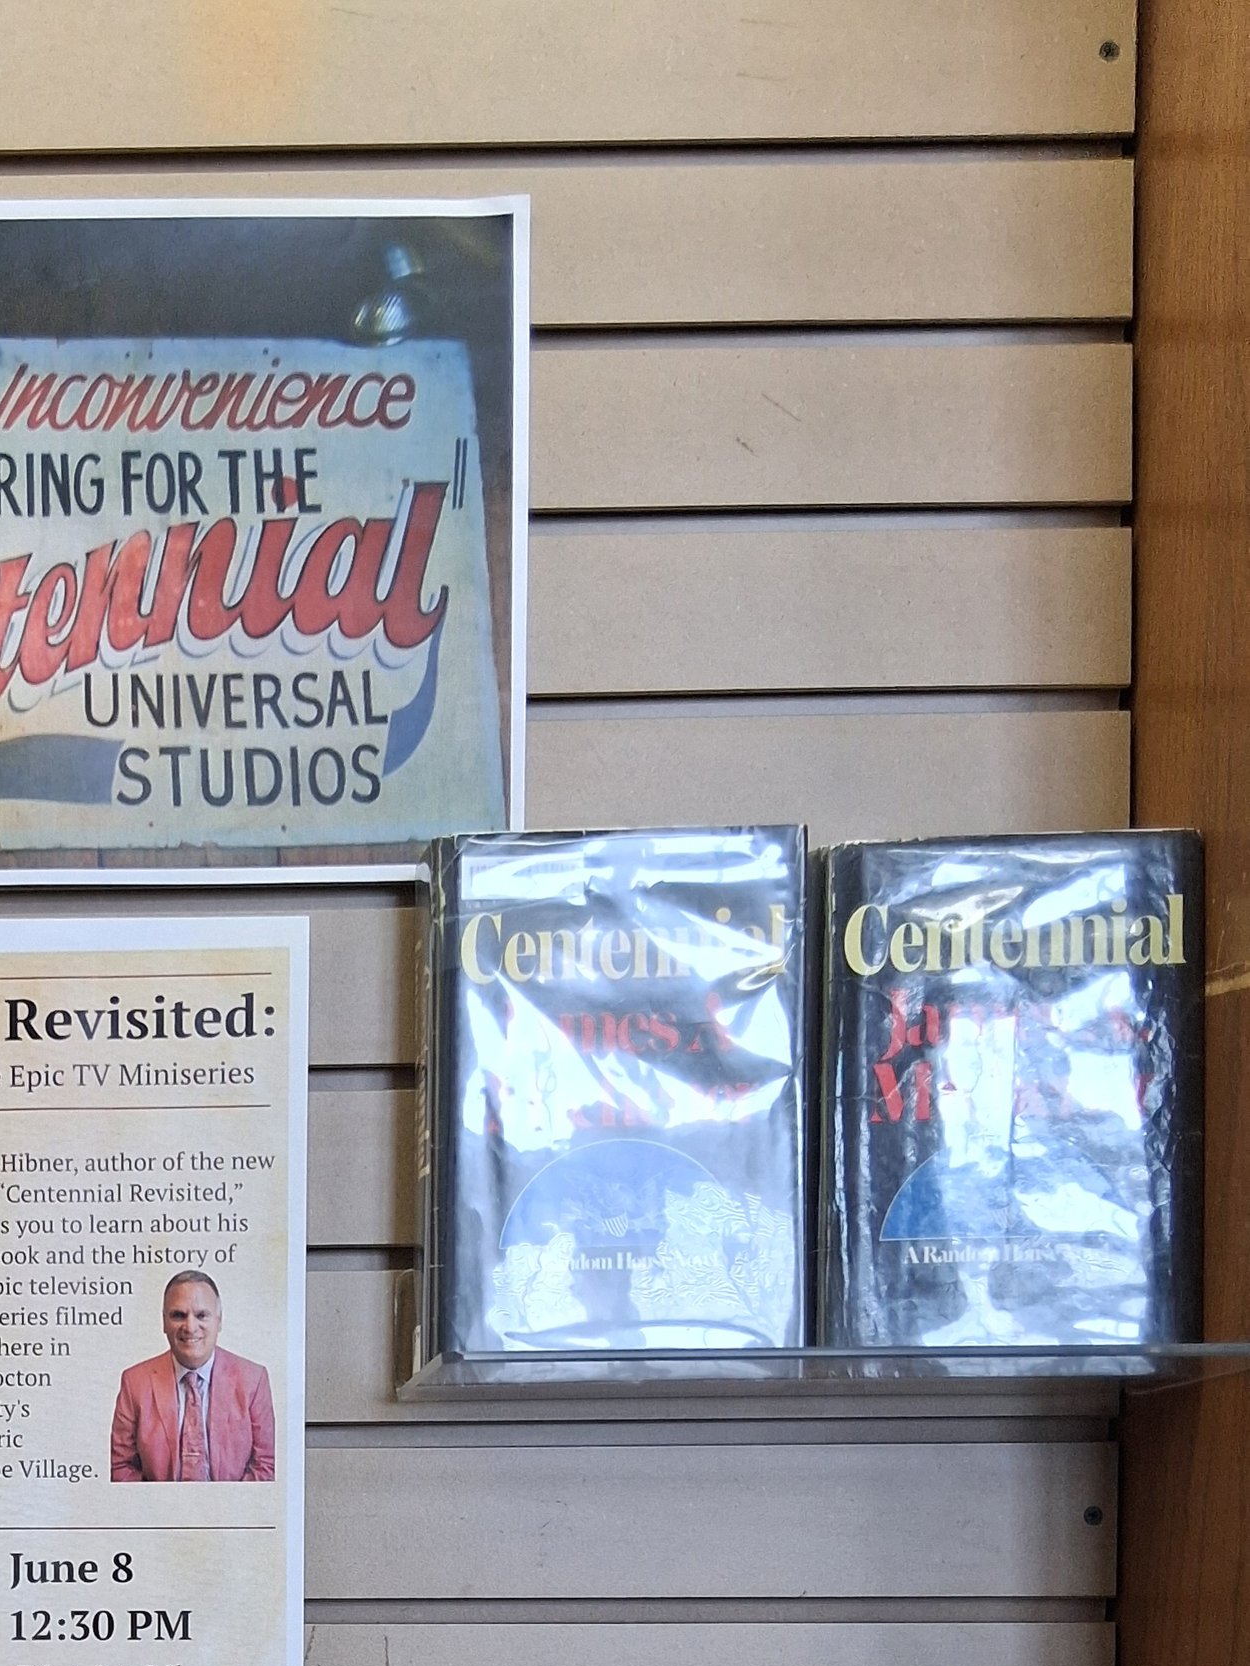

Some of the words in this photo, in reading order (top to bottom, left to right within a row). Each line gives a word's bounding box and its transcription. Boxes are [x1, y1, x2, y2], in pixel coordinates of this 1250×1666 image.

[121, 449, 209, 515] FOR
[217, 448, 322, 514] THE
[84, 670, 388, 729] UNIVERSAL
[116, 743, 382, 807] STUDIOS
[844, 894, 1187, 976] Centennial
[4, 991, 275, 1042] Revisited:
[9, 1063, 65, 1094] Epic
[72, 1063, 111, 1087] TV
[118, 1061, 255, 1087] Miniseries
[0, 1152, 79, 1176] Hibner,
[84, 1152, 157, 1173] author
[162, 1150, 186, 1172] of
[189, 1150, 225, 1171] the
[231, 1155, 276, 1170] new
[15, 1219, 55, 1239] you
[62, 1217, 83, 1234] to
[89, 1214, 144, 1234] learn
[150, 1213, 211, 1233] about
[217, 1212, 249, 1233] his
[45, 1244, 85, 1265] and
[92, 1244, 126, 1265] the
[132, 1244, 209, 1268] history
[214, 1242, 238, 1264] of
[29, 1275, 134, 1296] television
[55, 1305, 123, 1326] filmed
[50, 1337, 71, 1357] in
[18, 1458, 99, 1484] Village.
[10, 1552, 99, 1590] June
[111, 1552, 134, 1584] 8
[10, 1610, 115, 1641] 12:30
[126, 1610, 193, 1641] PM
